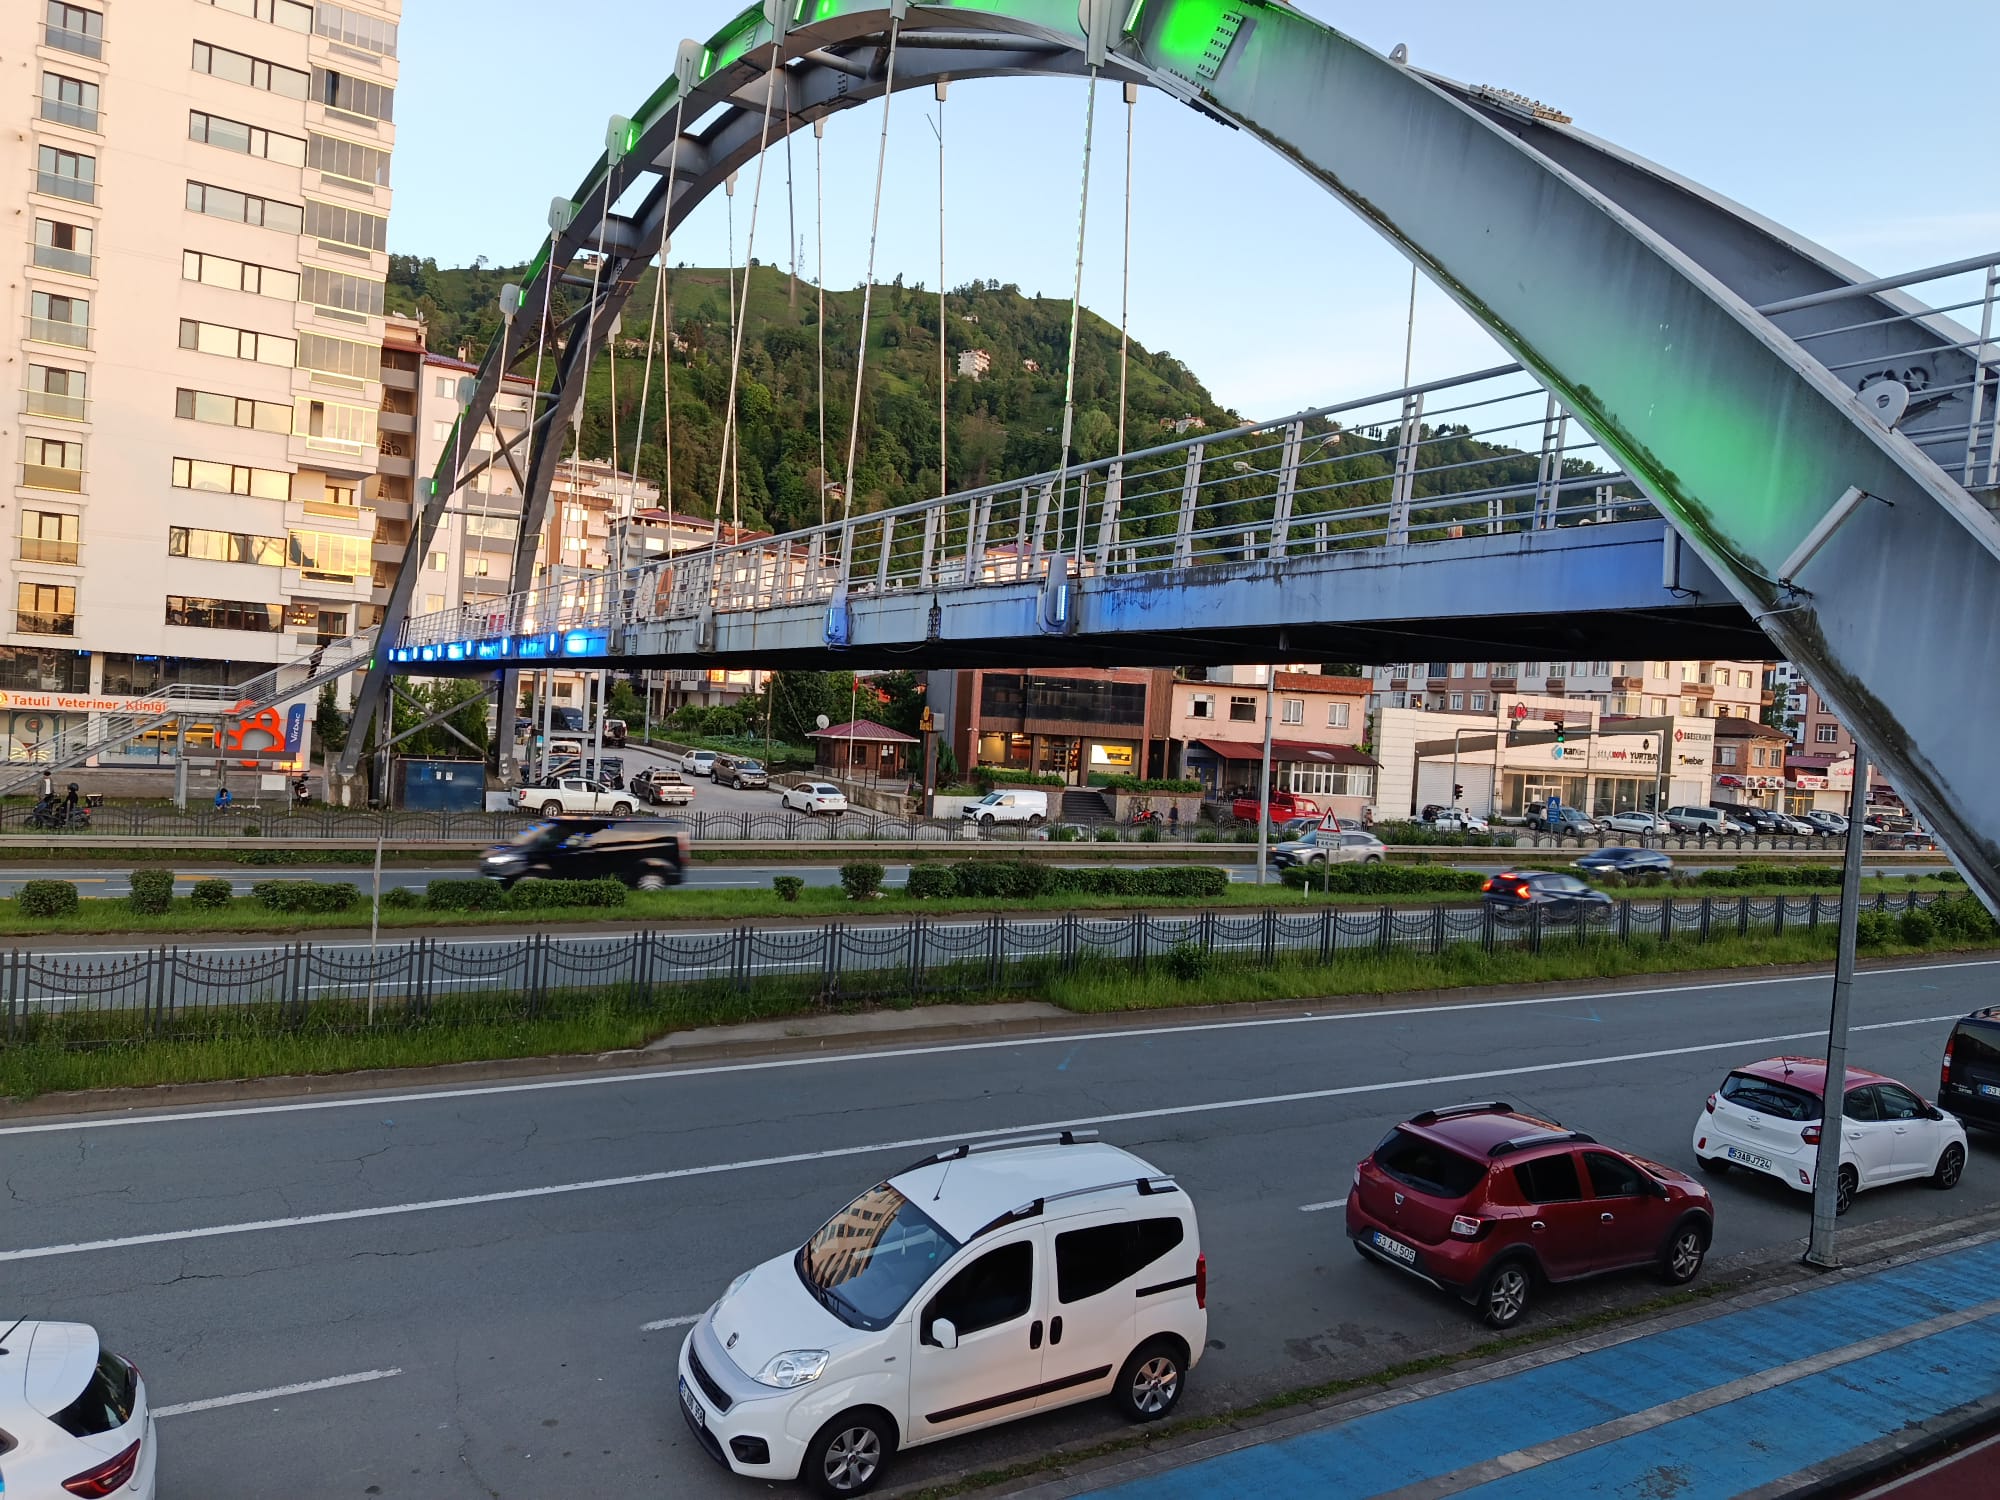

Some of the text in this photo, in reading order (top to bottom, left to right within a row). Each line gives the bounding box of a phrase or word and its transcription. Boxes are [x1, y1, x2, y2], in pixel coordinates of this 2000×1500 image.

[12, 695, 50, 707] Tatuli
[57, 697, 119, 710] Veteriner
[290, 712, 301, 743] Virbac
[1377, 1234, 1386, 1246] 53
[1387, 1240, 1399, 1252] AJ
[1400, 1246, 1415, 1261] 505
